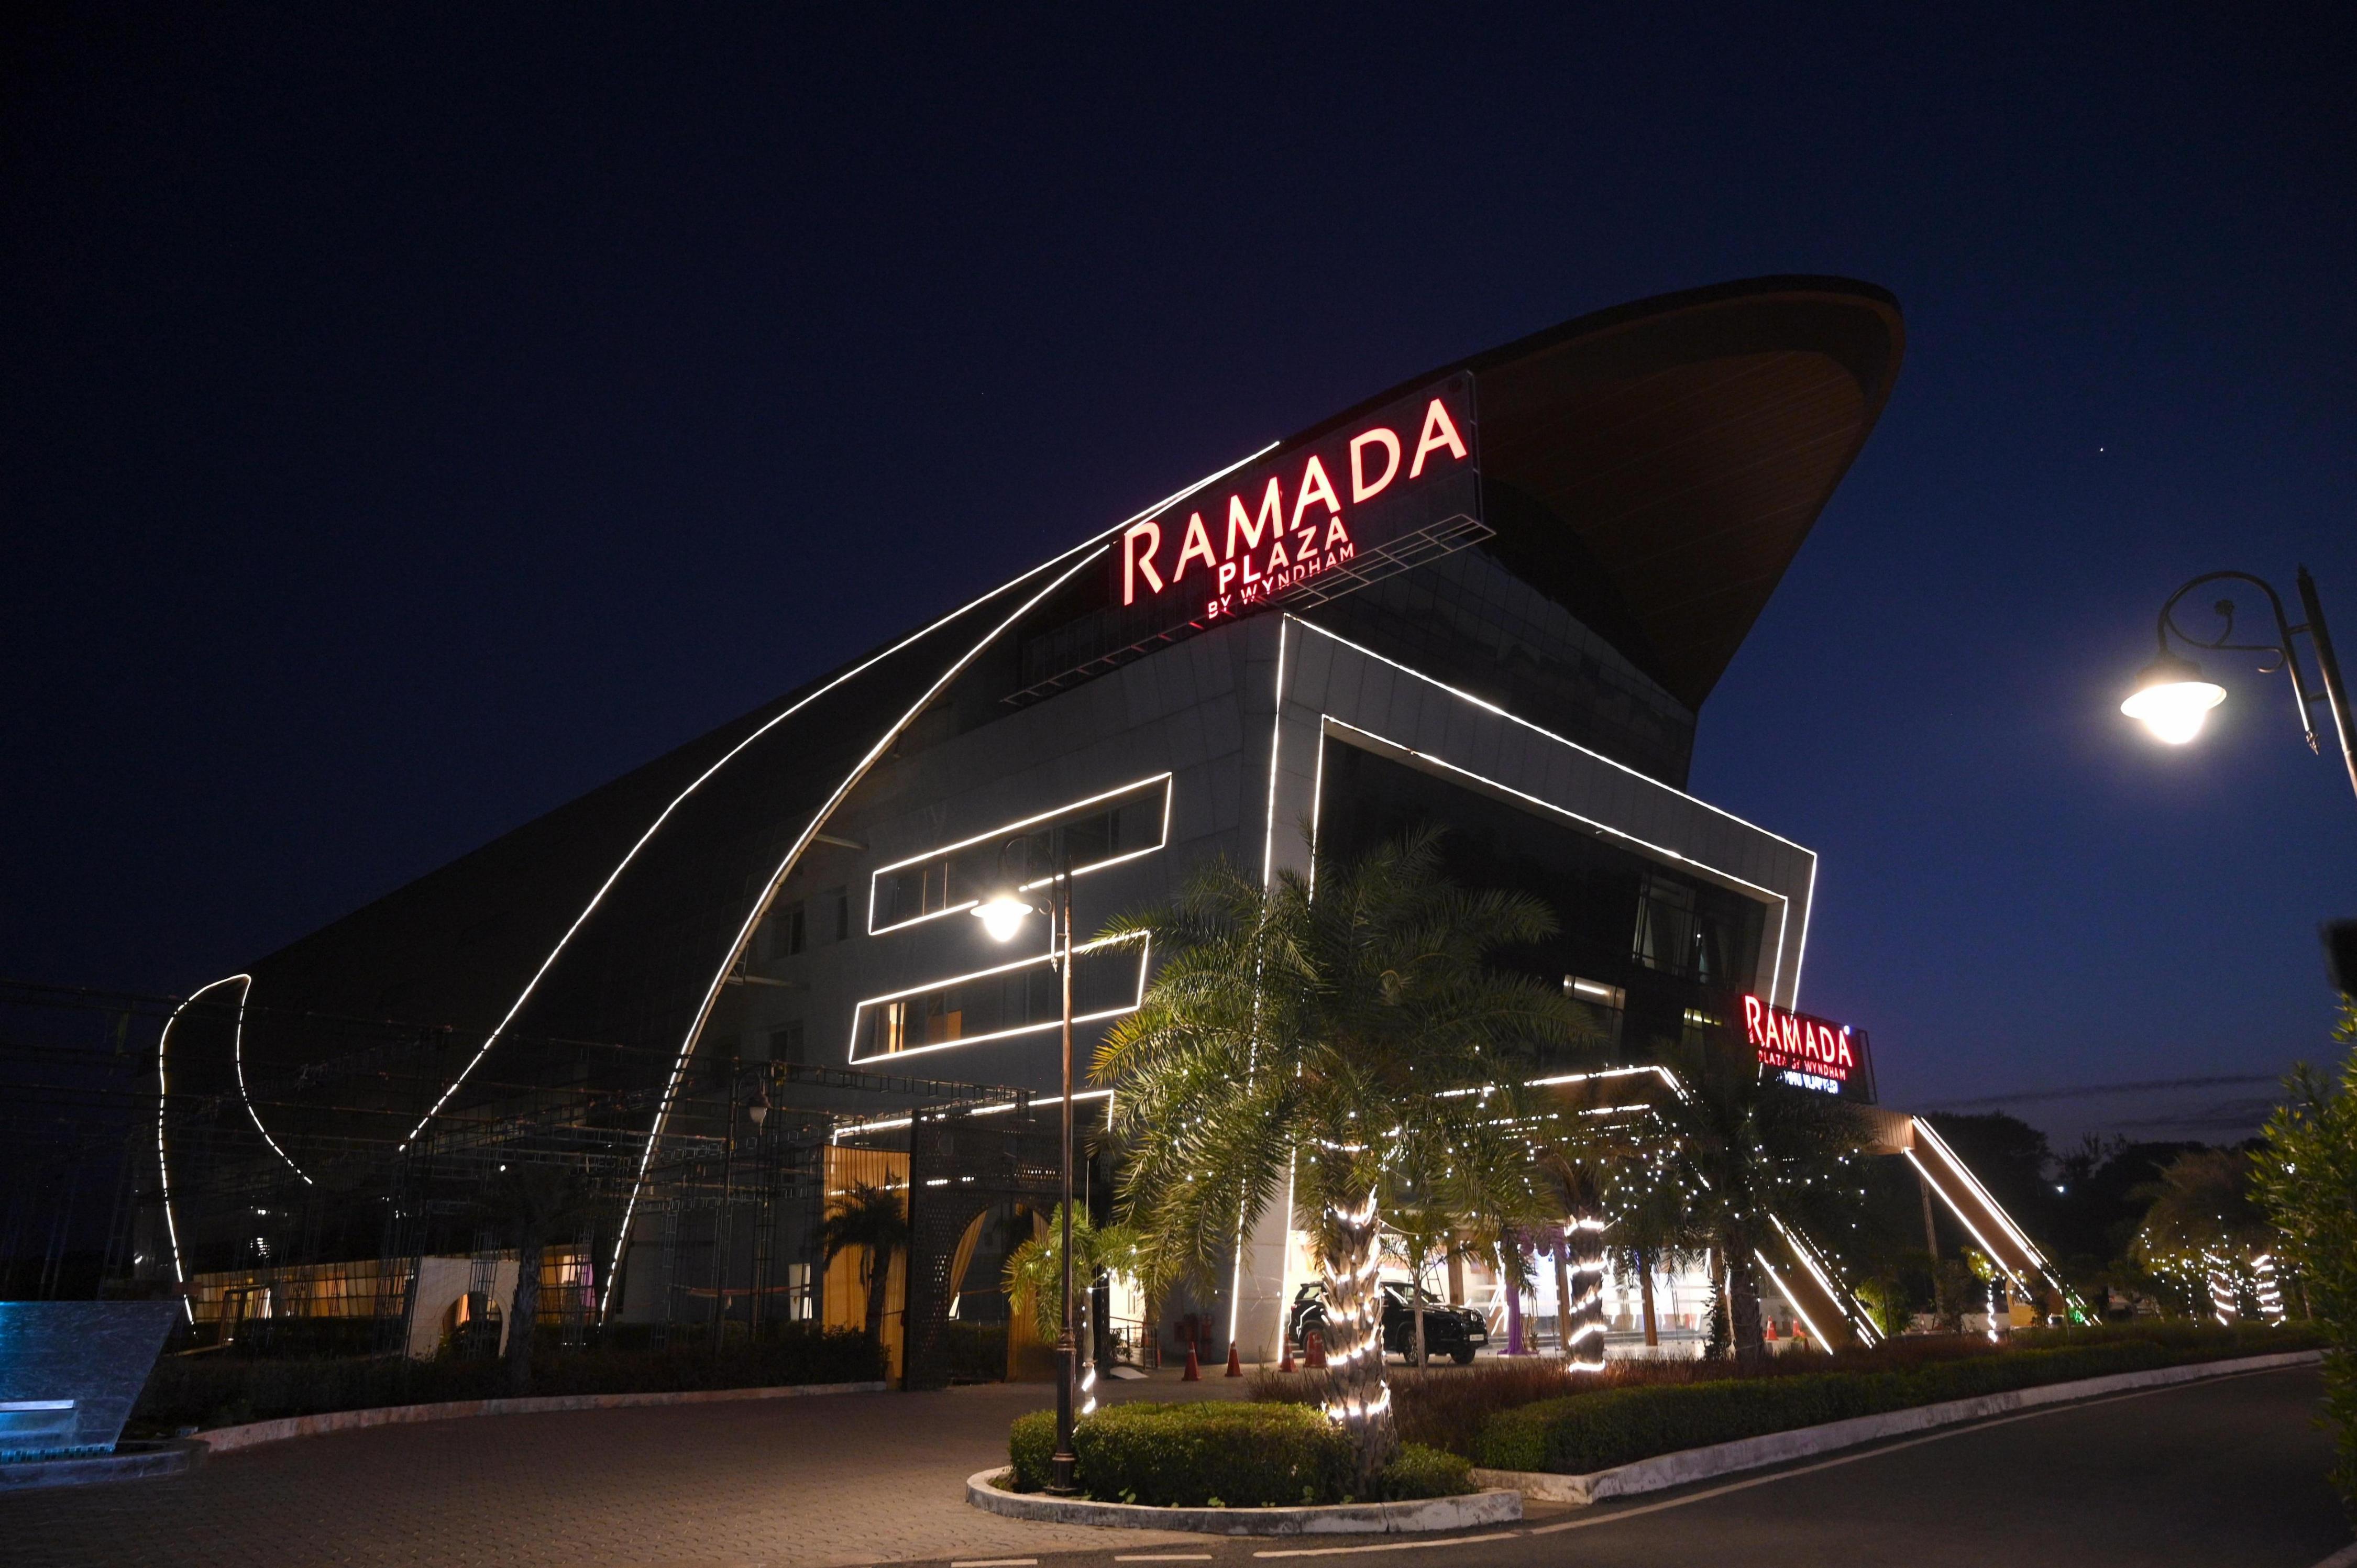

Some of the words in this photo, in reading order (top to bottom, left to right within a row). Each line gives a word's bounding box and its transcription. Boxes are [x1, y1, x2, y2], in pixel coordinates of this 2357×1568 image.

[1124, 399, 1467, 606] RAMADA
[1208, 594, 1231, 619] BY
[1241, 543, 1354, 605] WYNDHAM
[1219, 516, 1348, 595] PLAZA
[1745, 995, 1853, 1067] RAMADA
[1758, 1050, 1787, 1066] PLAZA
[1804, 1060, 1846, 1080] WYNDHAM
